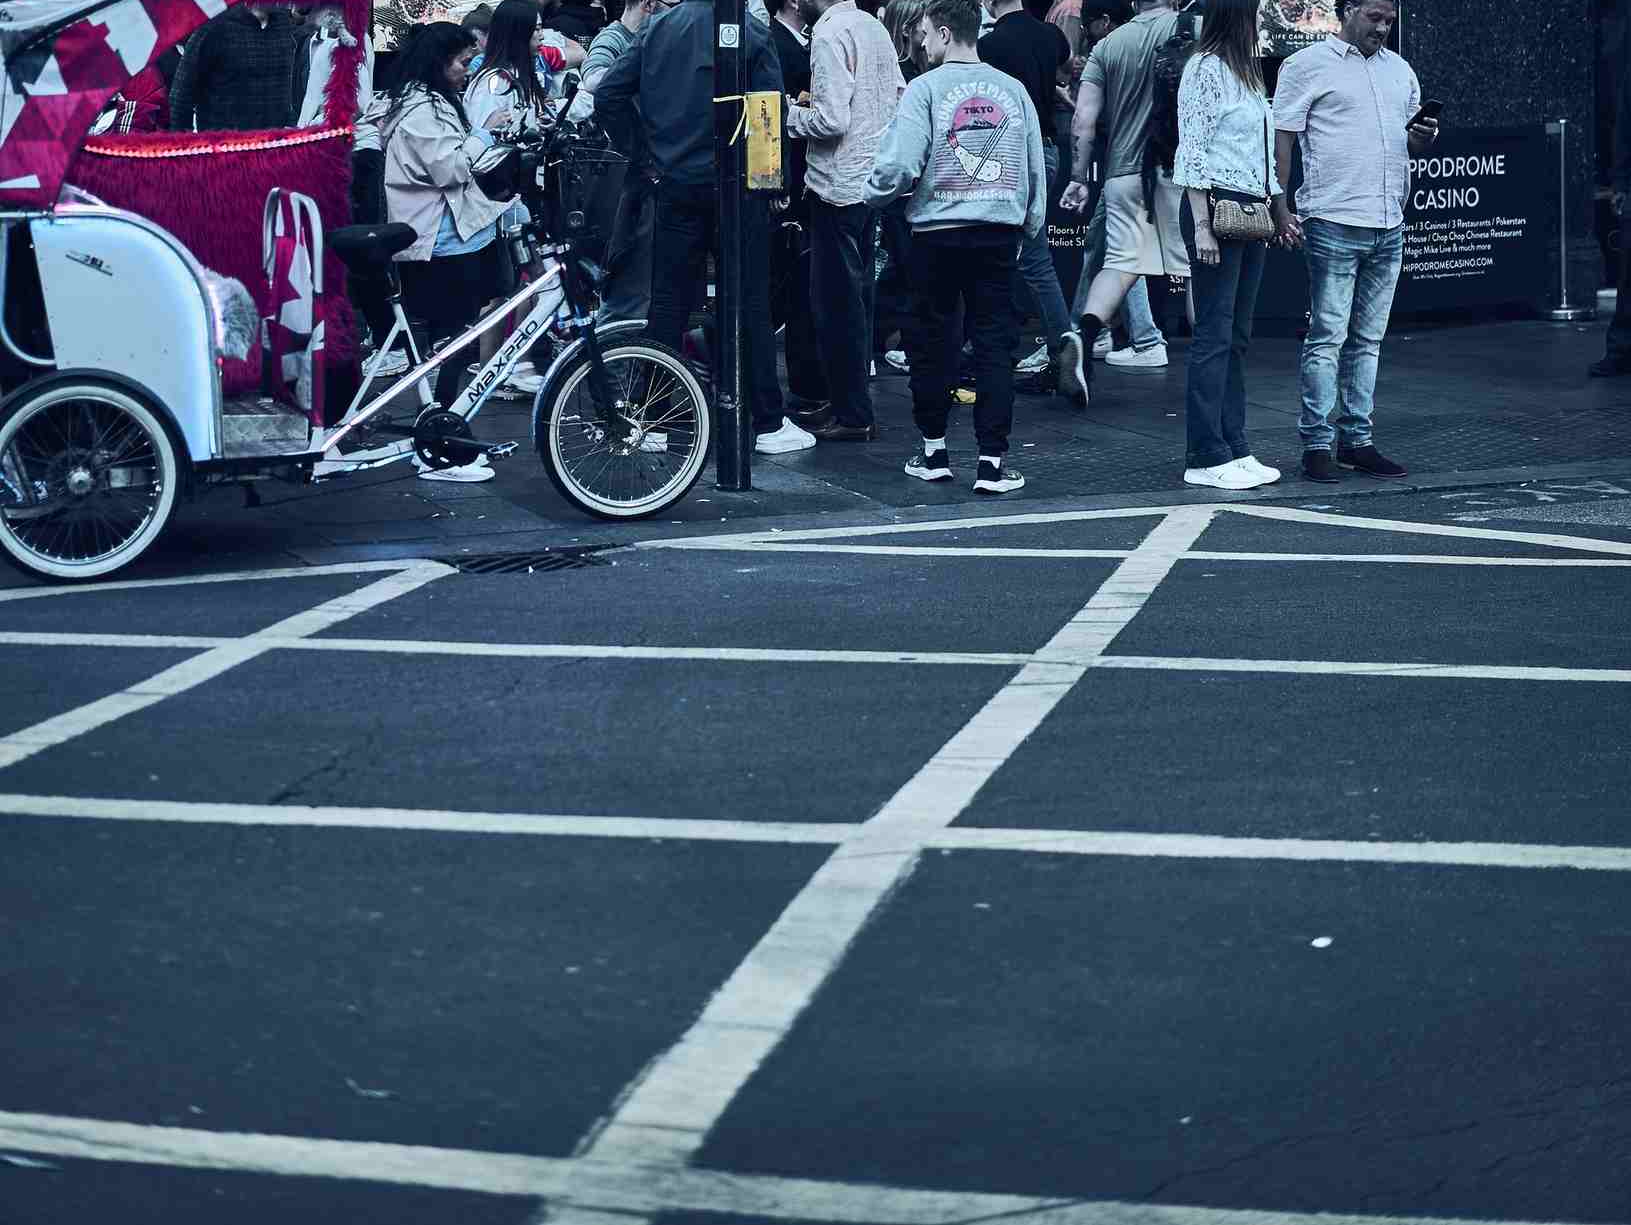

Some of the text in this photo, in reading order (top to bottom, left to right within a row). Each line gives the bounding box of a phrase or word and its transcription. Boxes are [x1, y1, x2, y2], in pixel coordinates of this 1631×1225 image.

[1271, 33, 1286, 41] LIFE
[1288, 33, 1304, 41] CAN
[1413, 186, 1480, 211] CASINO
[1047, 225, 1074, 235] Floors
[1424, 220, 1448, 231] Casinos
[1457, 217, 1491, 229] Restaurants
[1047, 237, 1074, 247] Heliot
[1408, 233, 1427, 243] House
[1432, 232, 1448, 244] Chop
[1449, 231, 1465, 243] Chop
[1466, 230, 1489, 239] Chinese
[1490, 229, 1522, 238] Restaurant
[1404, 246, 1423, 258] Magic
[1423, 245, 1438, 254] Mike
[1458, 242, 1475, 252] much
[1476, 243, 1491, 251] more
[1402, 257, 1493, 273] HIPPODROMECASINO.COM
